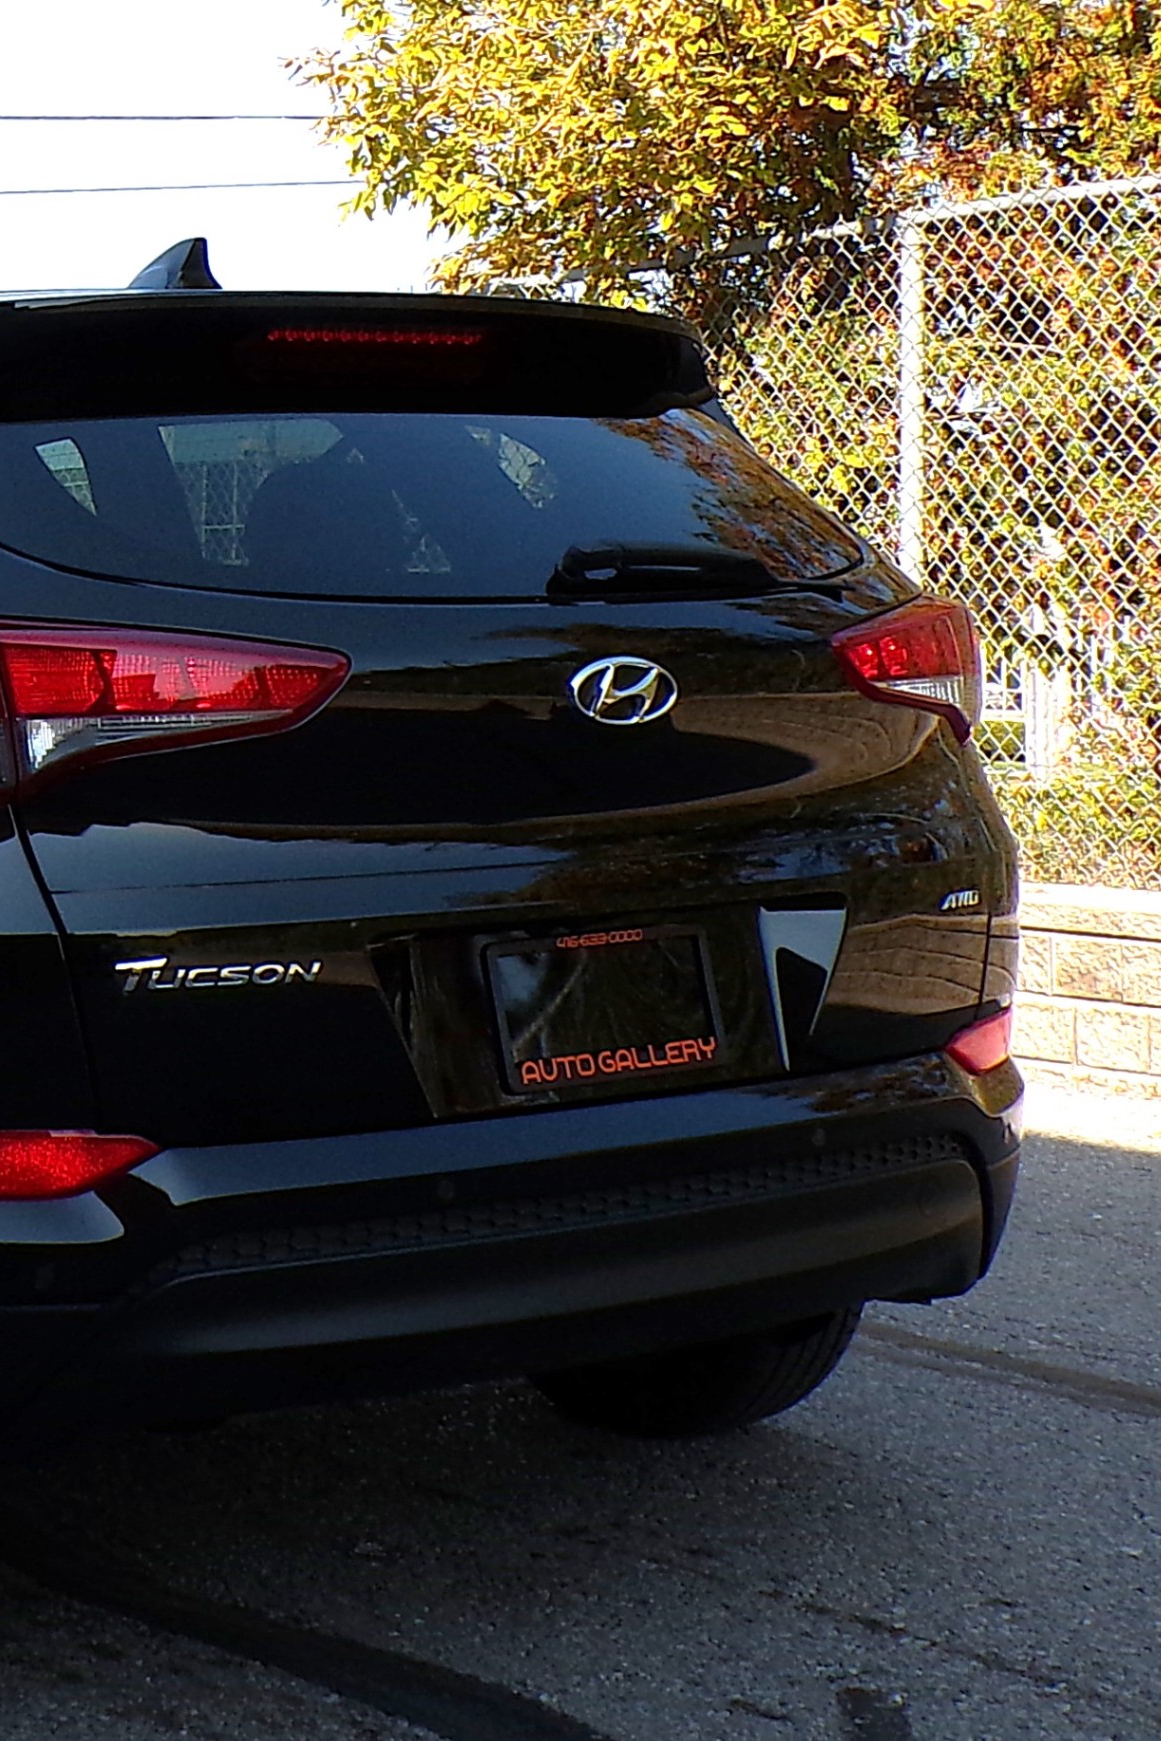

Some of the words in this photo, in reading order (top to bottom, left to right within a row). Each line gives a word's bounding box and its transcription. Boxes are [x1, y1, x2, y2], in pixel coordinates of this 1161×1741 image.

[114, 957, 322, 993] TUCSON
[521, 1053, 596, 1084] AUTO
[597, 1036, 716, 1073] GALLERY
